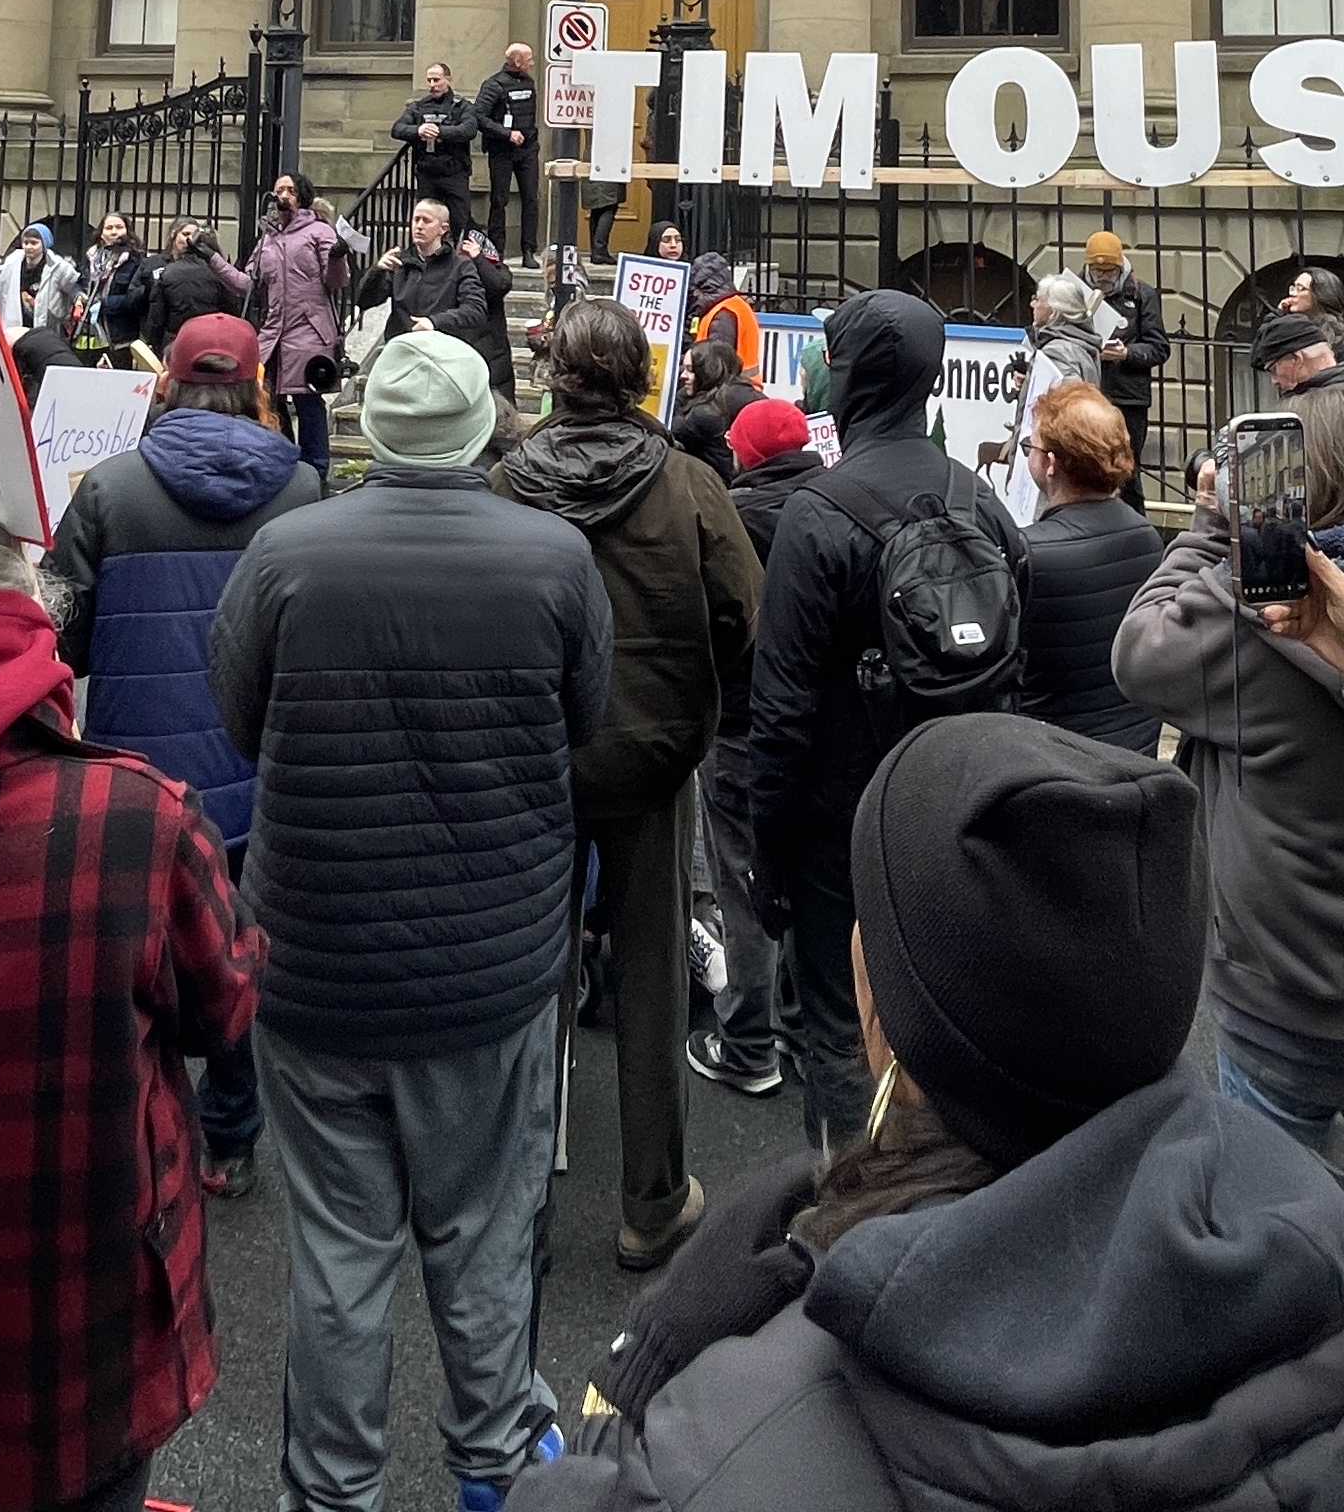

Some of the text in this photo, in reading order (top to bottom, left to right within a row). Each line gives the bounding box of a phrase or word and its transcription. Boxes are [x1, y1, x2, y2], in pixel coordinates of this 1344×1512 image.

[554, 89, 595, 102] AWAY
[556, 105, 594, 118] ZONE
[571, 50, 878, 190] TIM
[628, 272, 677, 296] STOP
[639, 294, 664, 310] THE
[36, 398, 137, 469] Accessible
[808, 423, 838, 441] TOP
[815, 440, 834, 452] THE
